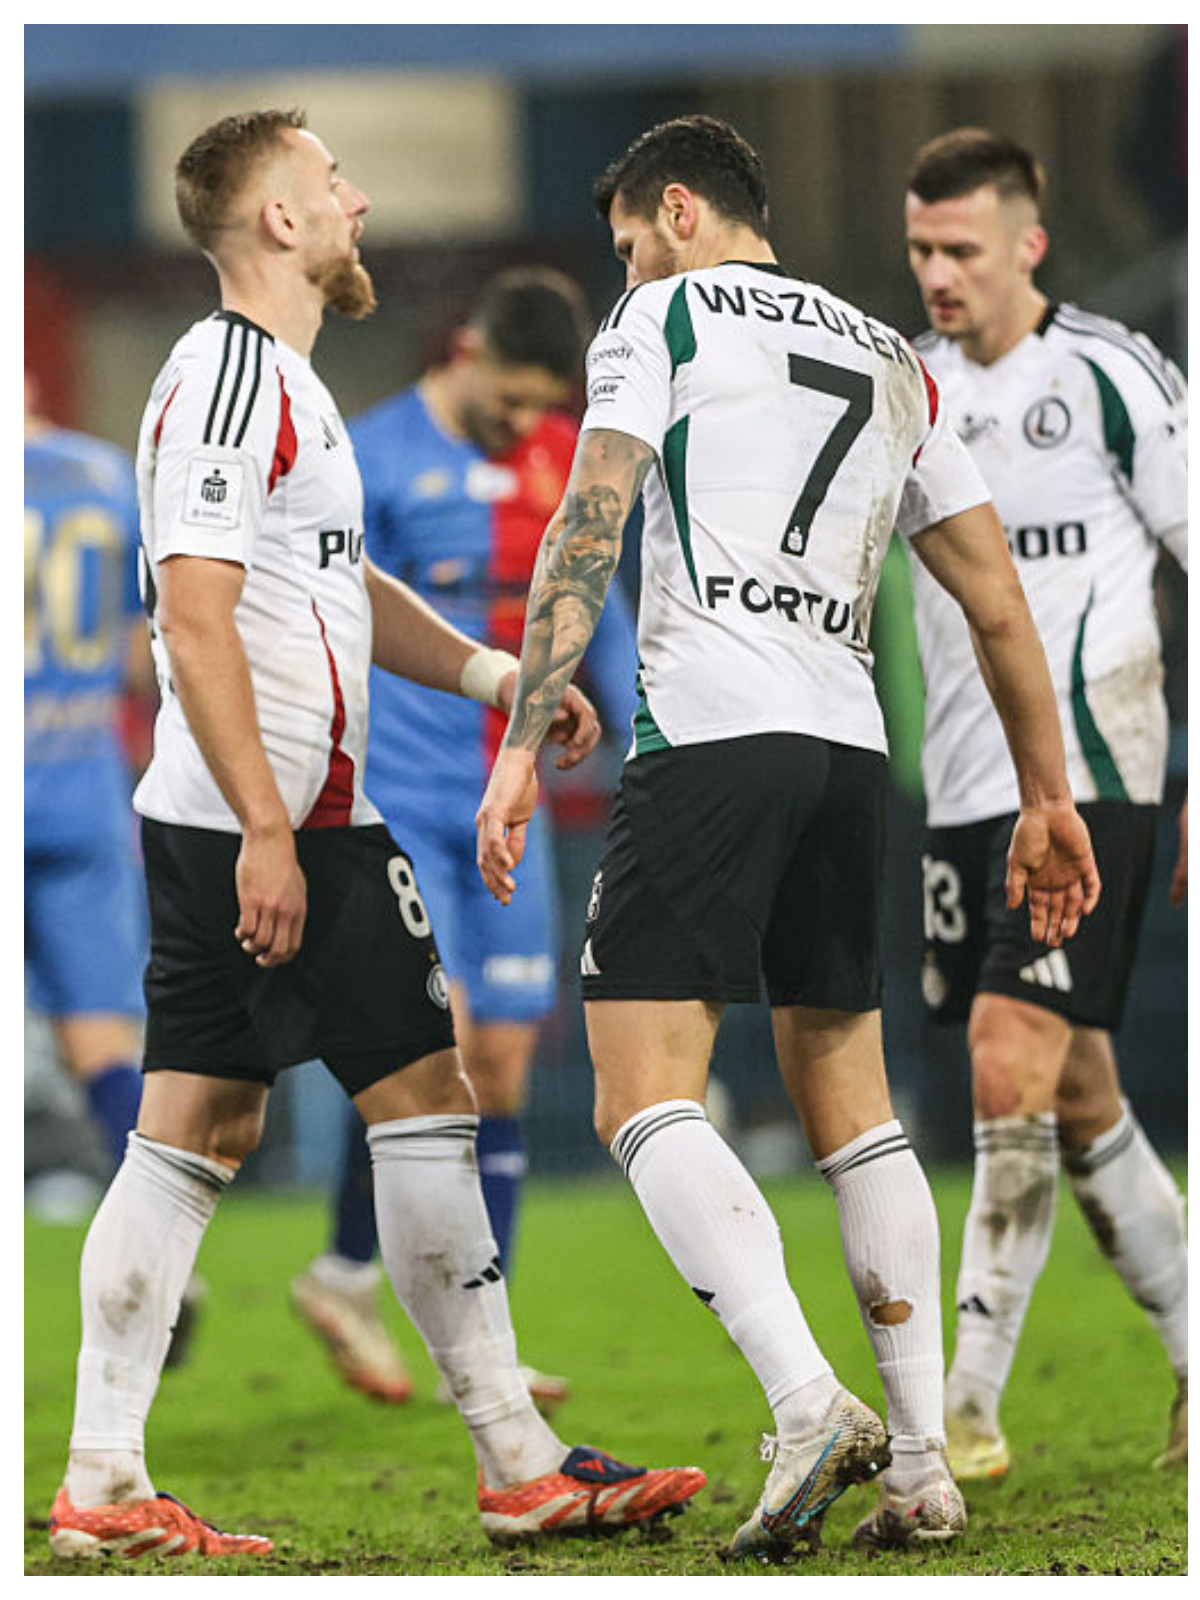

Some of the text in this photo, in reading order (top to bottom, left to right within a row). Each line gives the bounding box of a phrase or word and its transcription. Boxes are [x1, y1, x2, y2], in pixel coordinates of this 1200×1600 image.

[781, 353, 874, 558] 7
[1004, 521, 1087, 559] 00
[24, 506, 122, 673] 0
[387, 855, 430, 938] 8
[922, 854, 967, 942] 13
